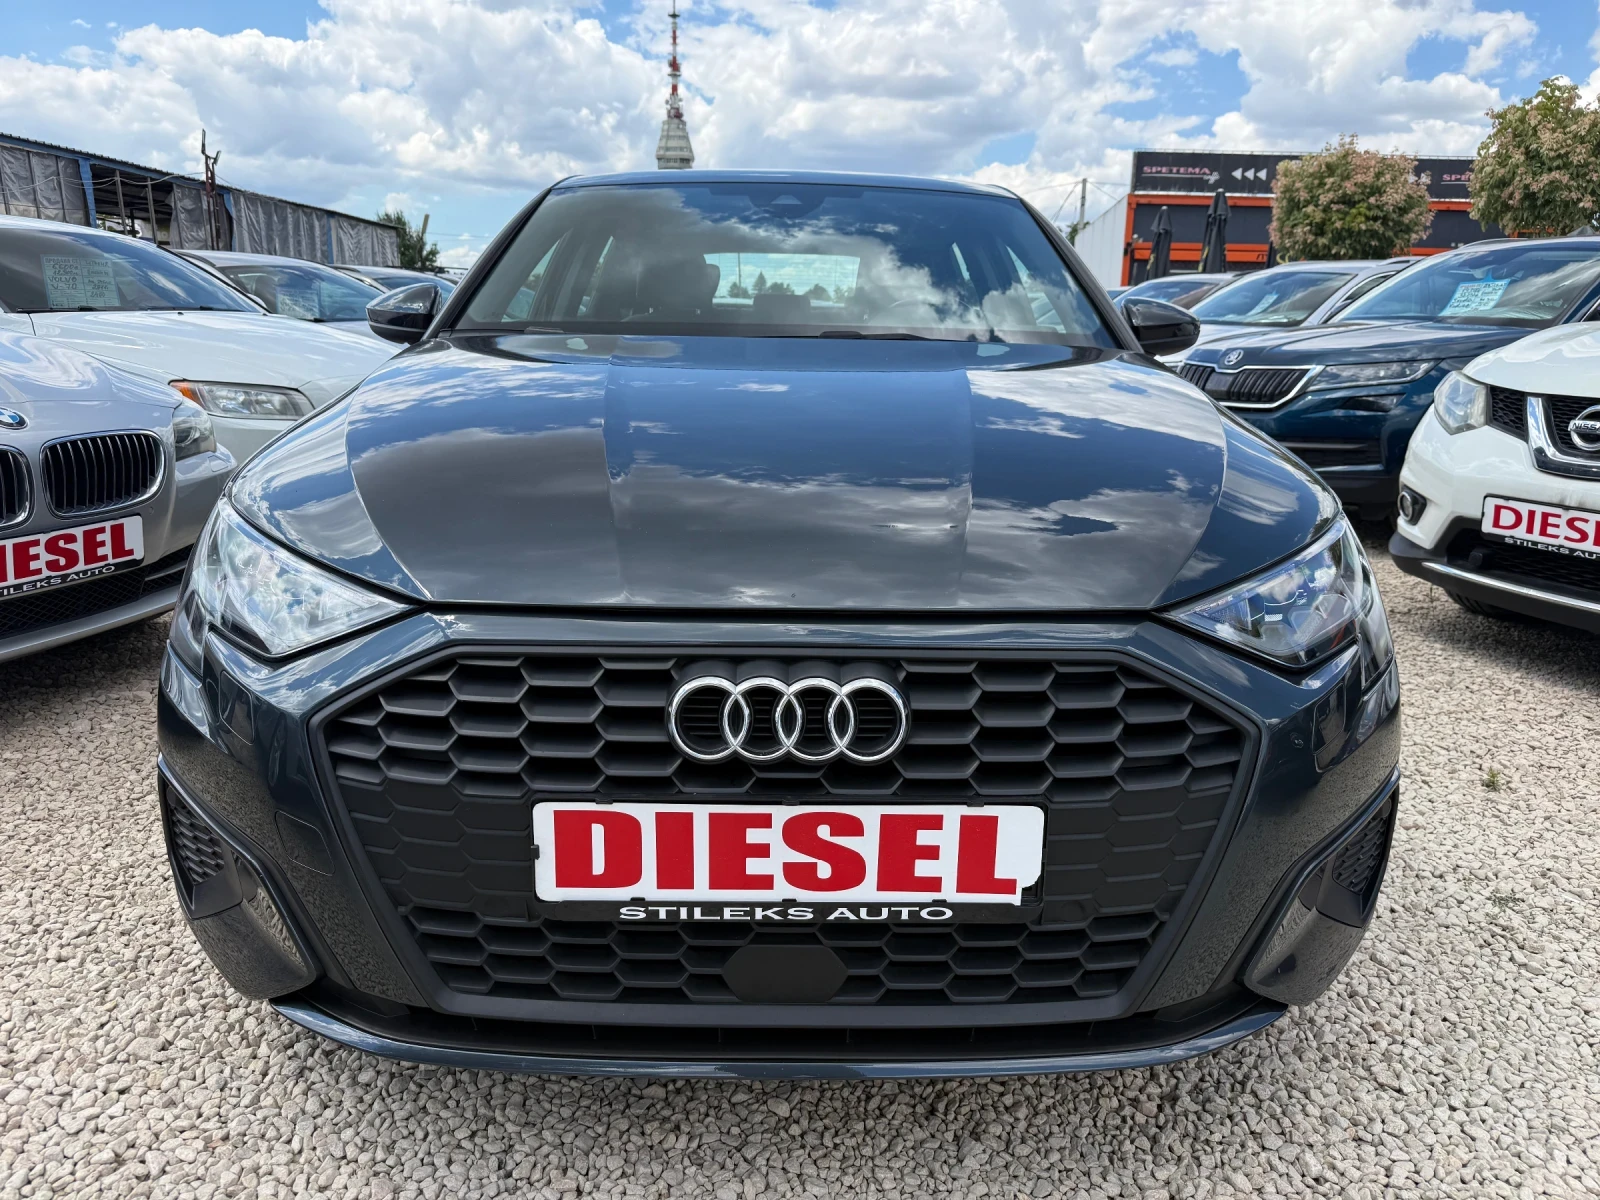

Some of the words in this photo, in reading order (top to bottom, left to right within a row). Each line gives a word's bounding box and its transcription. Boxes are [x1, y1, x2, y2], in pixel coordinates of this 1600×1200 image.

[1143, 166, 1211, 175] SPETEMA
[1442, 173, 1470, 181] SPE
[1504, 537, 1569, 554] STILEKS
[67, 565, 115, 581] AUTO
[553, 809, 1018, 895] DIESEL
[619, 906, 814, 920] STILEKS
[826, 907, 953, 920] AUTO
